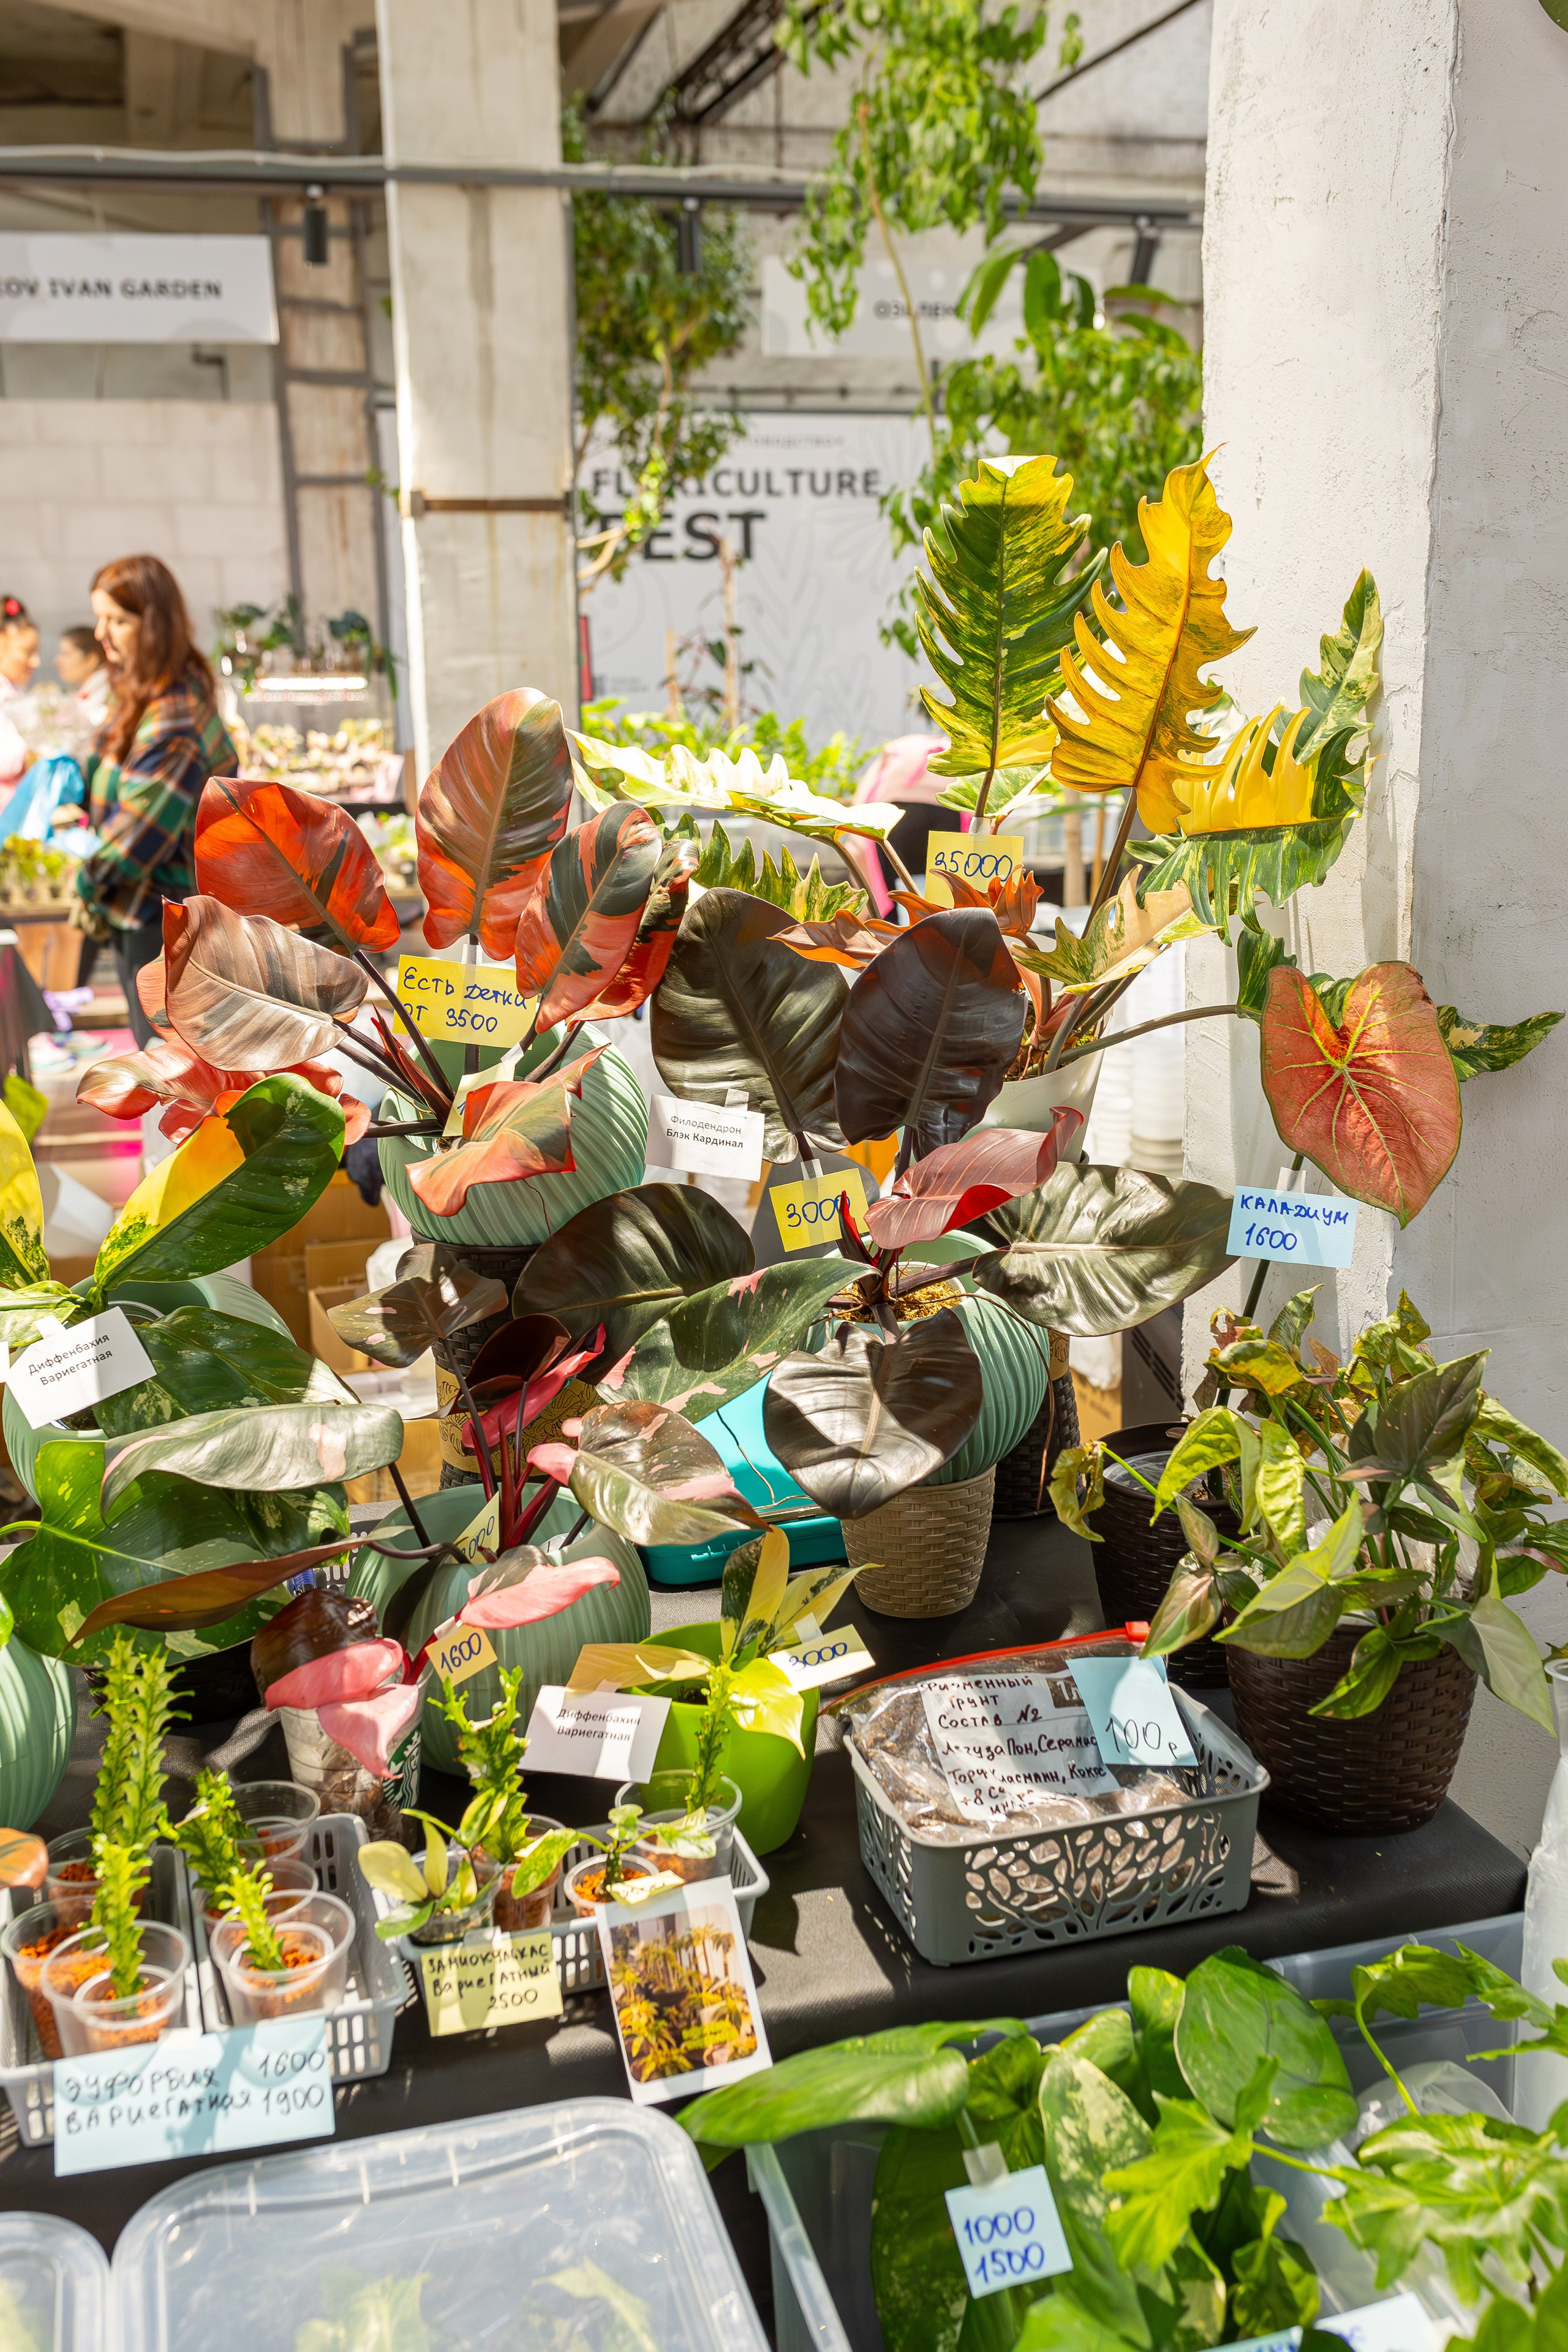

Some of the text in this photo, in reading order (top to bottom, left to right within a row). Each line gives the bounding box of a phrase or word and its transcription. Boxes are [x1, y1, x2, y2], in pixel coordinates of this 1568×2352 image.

[0, 276, 222, 299] OV IVAN GARDEN
[592, 467, 882, 497] FLCULTURE
[404, 967, 454, 995] Есть
[446, 1008, 498, 1033] 3500
[666, 1128, 743, 1148] Блэк Кардинал
[671, 1115, 741, 1134] Филодендрон
[786, 1194, 850, 1227] 3000
[1241, 1194, 1349, 1226] КАЛАДИУМ
[1245, 1223, 1297, 1251] 1600
[29, 1335, 110, 1376] Диффенбахия
[40, 1350, 113, 1385] Вариегатная
[441, 1632, 481, 1673] 1600
[788, 1642, 848, 1671] 3000
[557, 1709, 641, 1725] Диффенбахия
[557, 1726, 630, 1741] Вариегатная
[1106, 1717, 1161, 1754] 100
[488, 1988, 537, 2010] 2500
[259, 2048, 325, 2078] 1600
[263, 2083, 324, 2116] 1900
[964, 2206, 1035, 2246] 1000
[975, 2241, 1045, 2285] 1500
